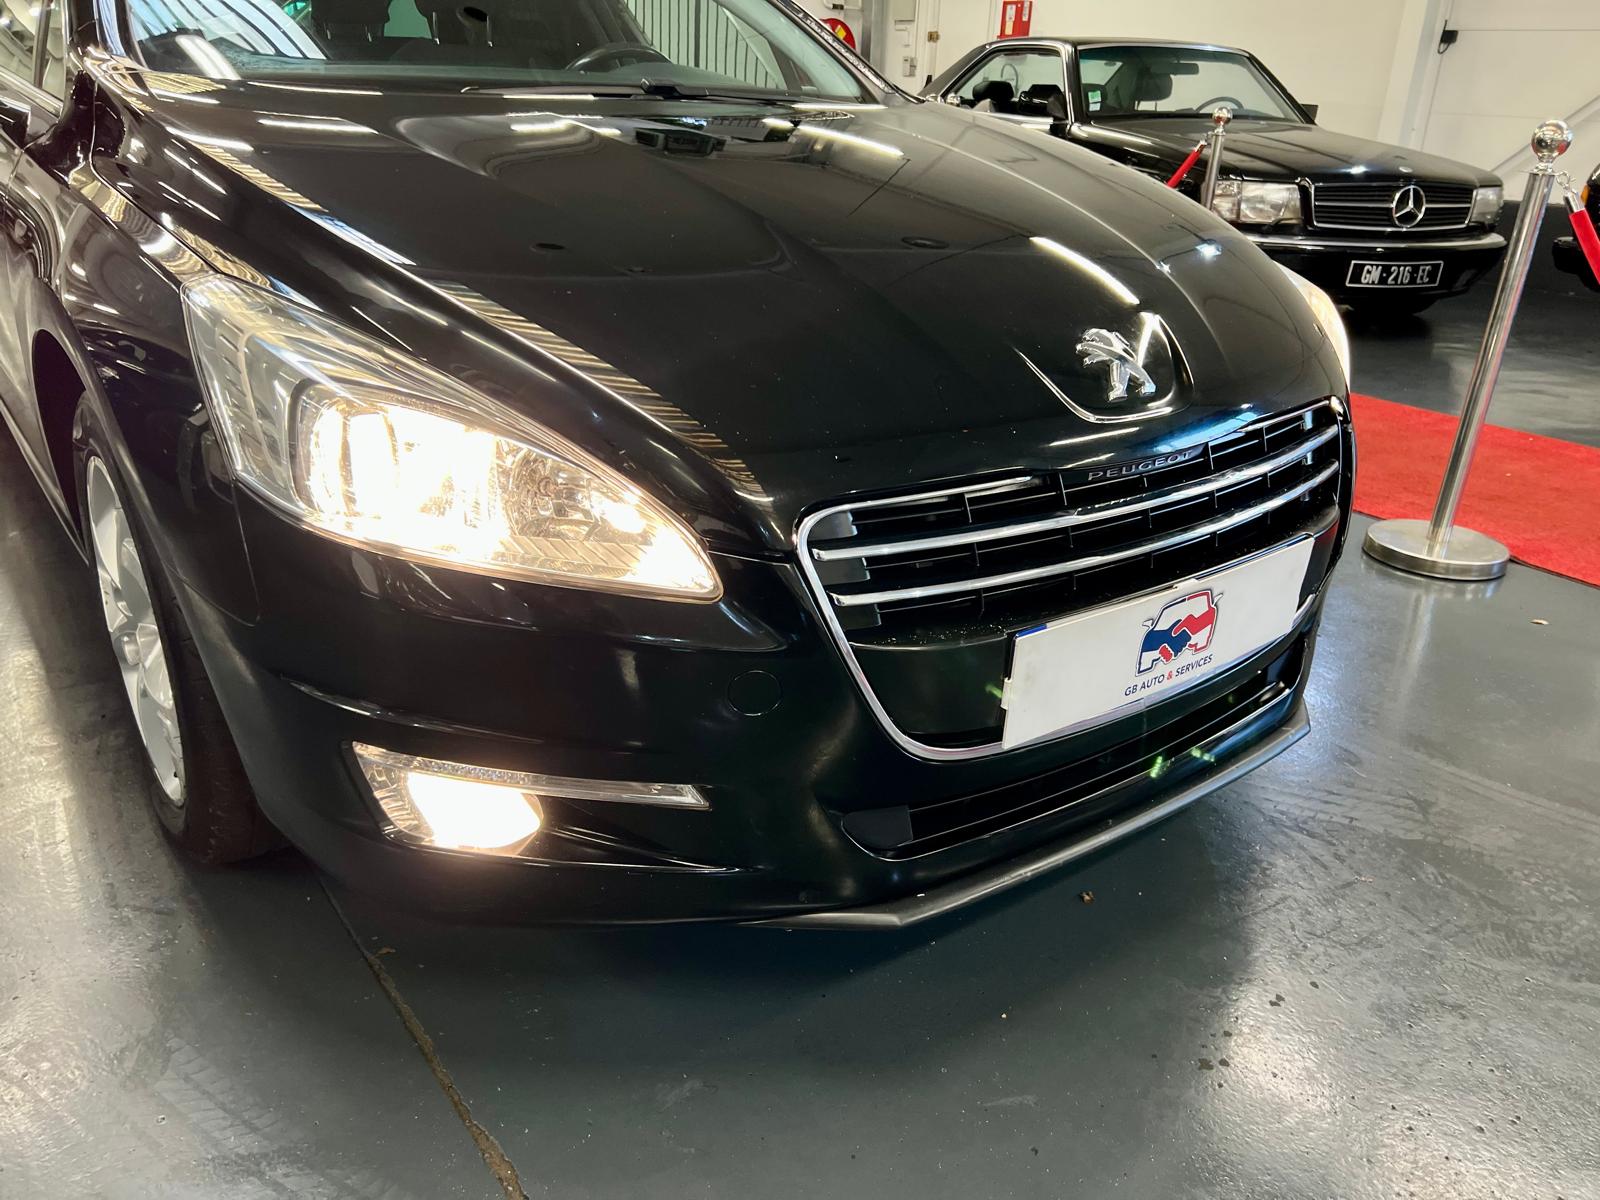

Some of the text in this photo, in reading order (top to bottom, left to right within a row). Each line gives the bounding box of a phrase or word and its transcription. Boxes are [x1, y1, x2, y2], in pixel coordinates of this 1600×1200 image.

[1087, 449, 1193, 481] PEUGEOT
[1124, 654, 1213, 697] GB AUTO & SERVICES
